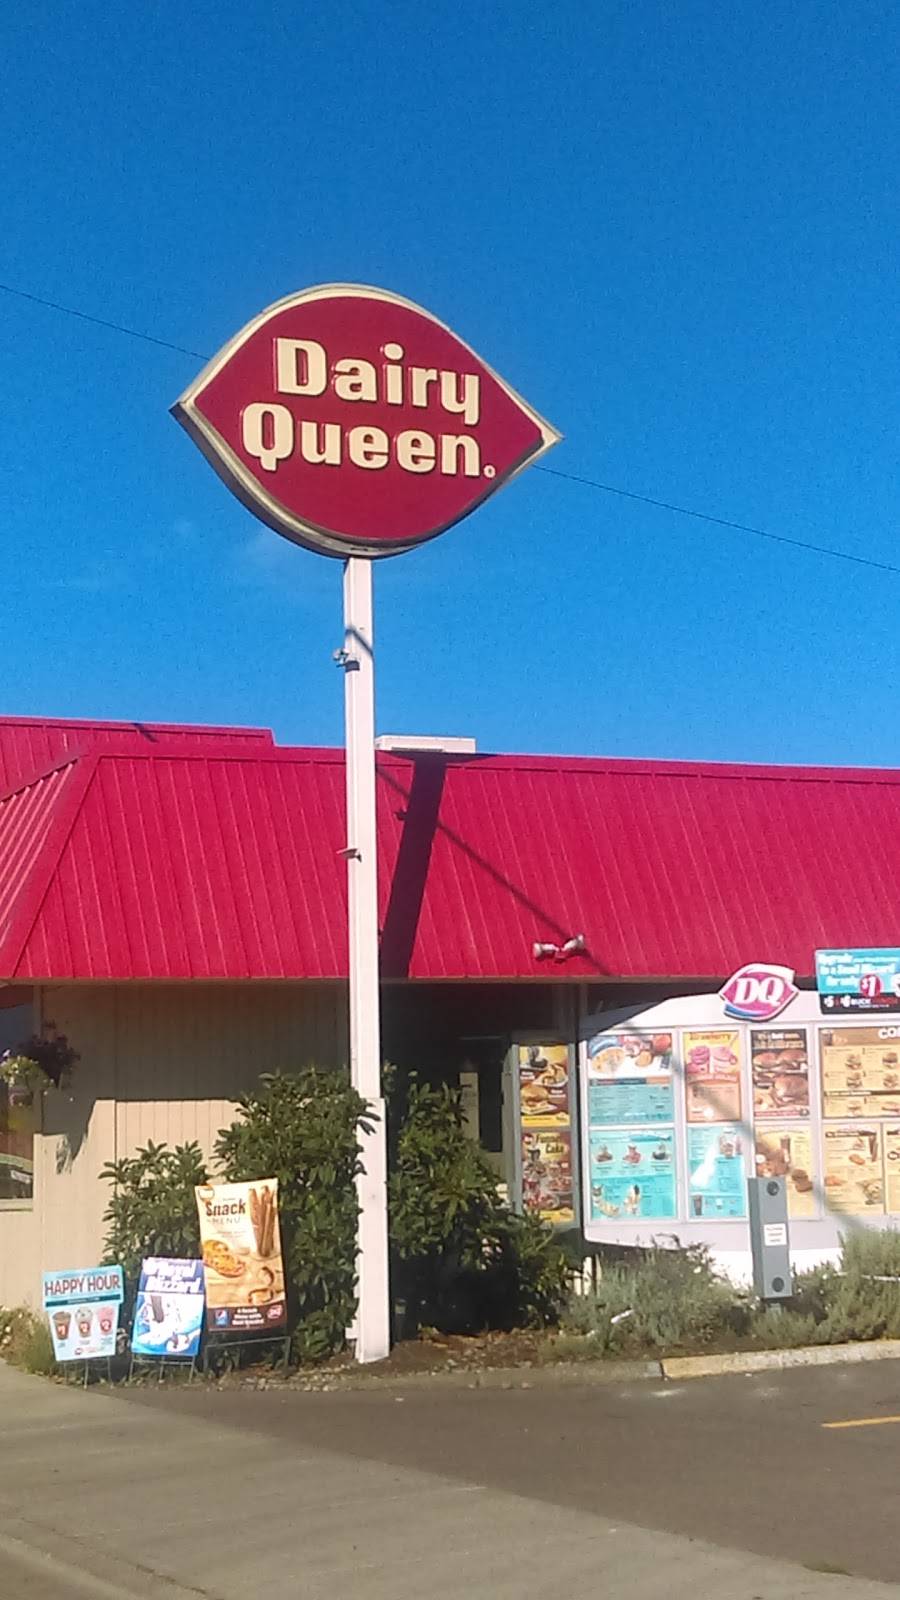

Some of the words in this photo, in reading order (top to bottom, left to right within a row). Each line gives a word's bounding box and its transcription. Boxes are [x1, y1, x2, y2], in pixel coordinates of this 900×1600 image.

[275, 337, 481, 426] Dairy
[733, 976, 785, 1007] DQ
[205, 1198, 247, 1217] Snack
[44, 1278, 85, 1297] HAPPY
[87, 1274, 121, 1292] HOUR
